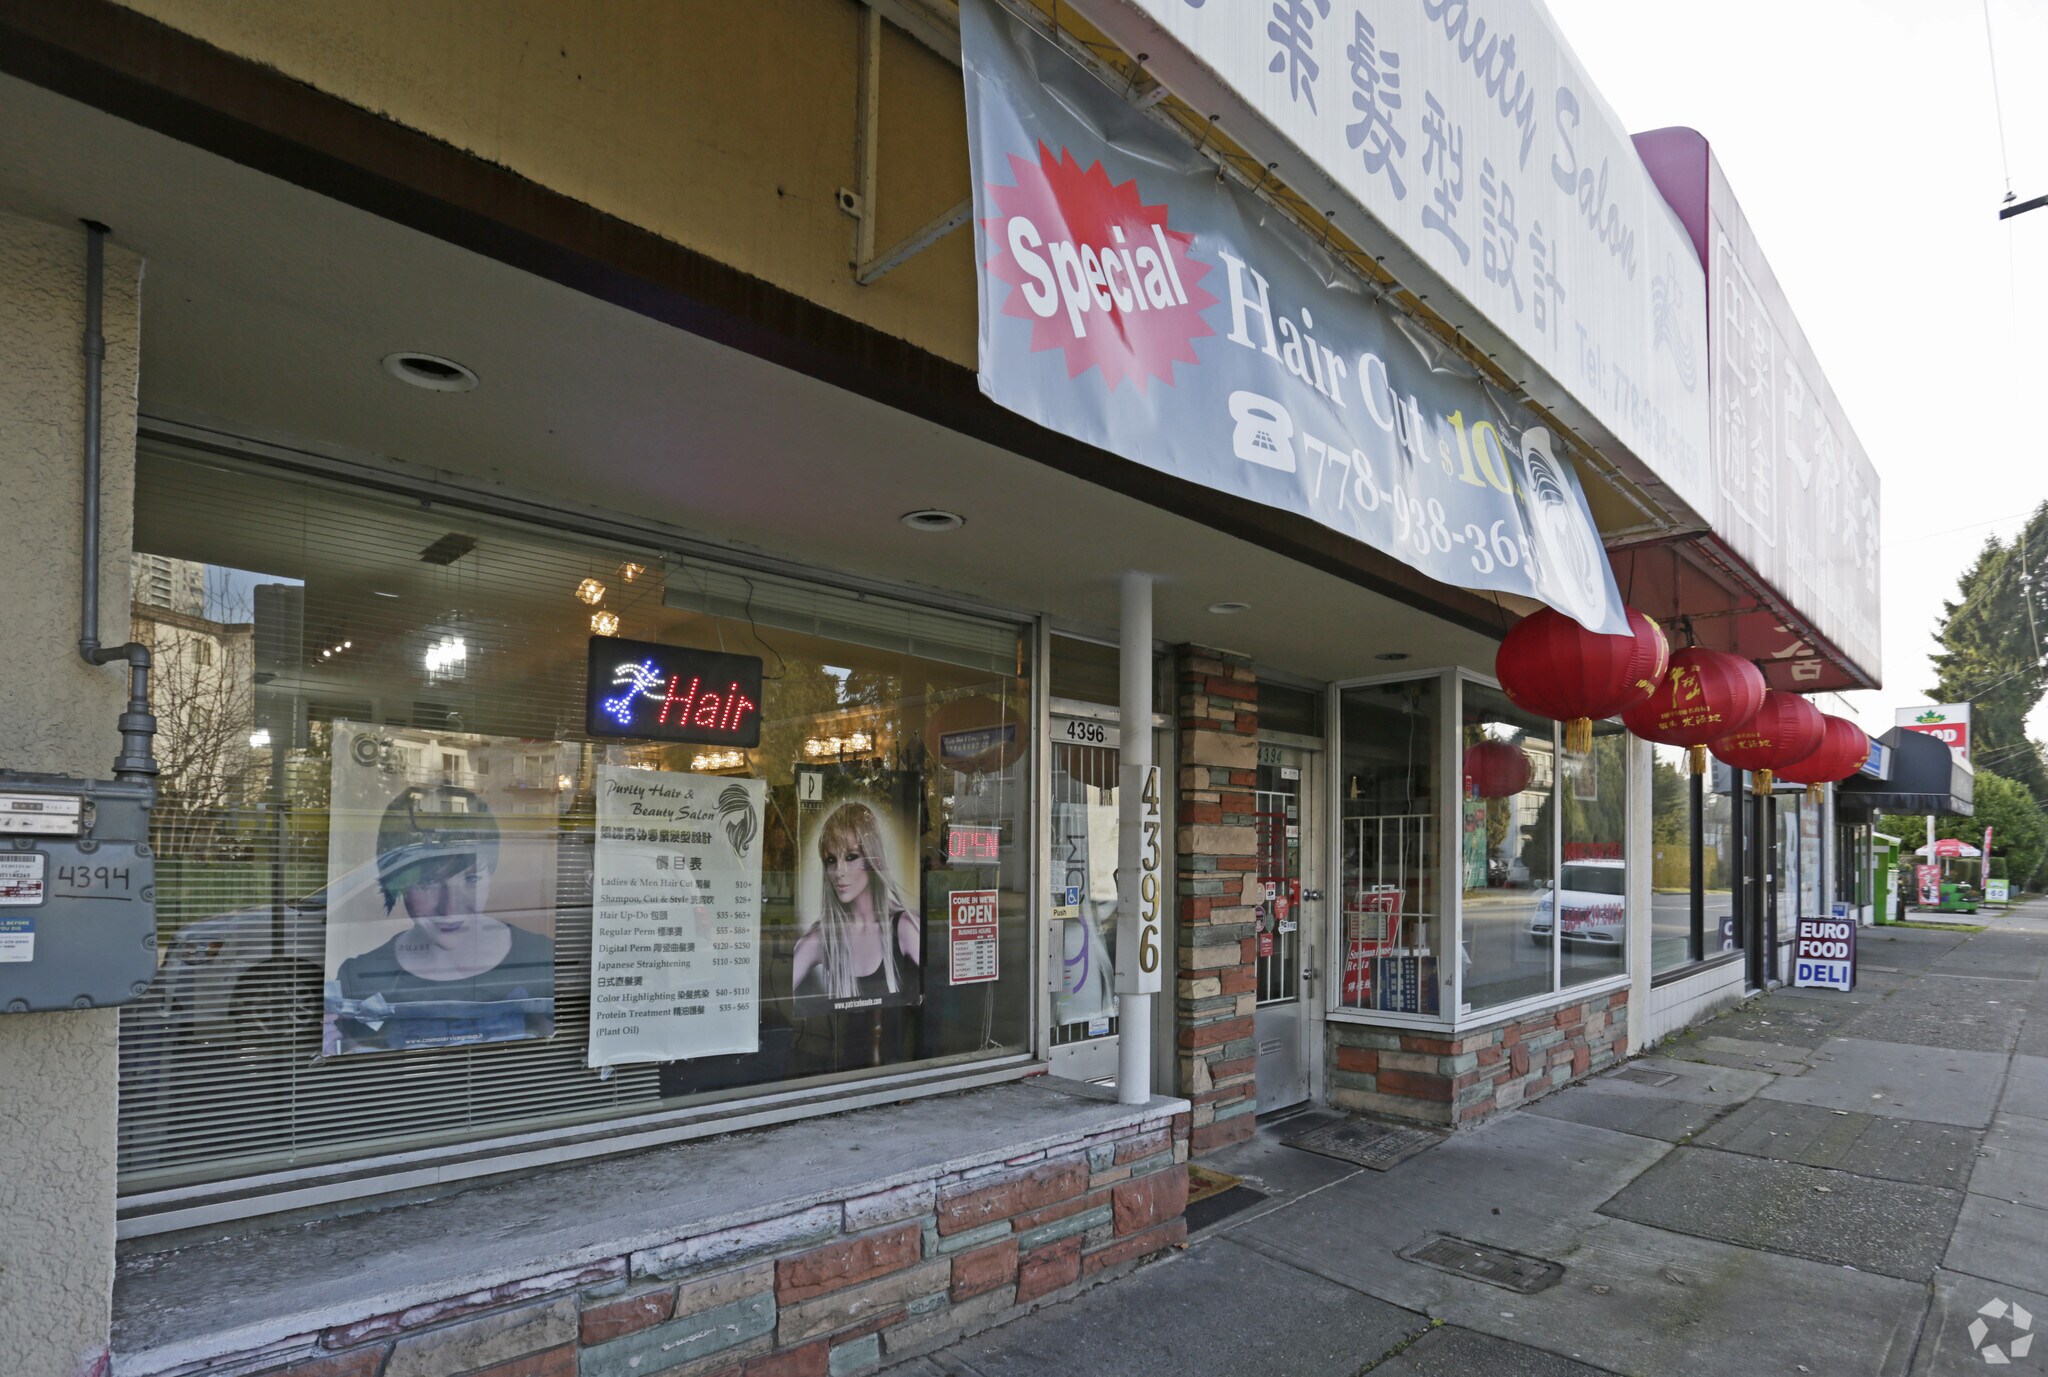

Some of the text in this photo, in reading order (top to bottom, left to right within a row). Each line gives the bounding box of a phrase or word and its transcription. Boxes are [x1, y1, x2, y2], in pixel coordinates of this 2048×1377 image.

[1184, 0, 1565, 353] 業髮型設計
[1551, 86, 1637, 282] Salon
[1006, 215, 1189, 339] Special
[1218, 249, 1347, 411] Hair
[1358, 352, 1431, 464] Cut
[659, 675, 754, 730] Hair
[1066, 721, 1105, 744] 4396
[604, 779, 694, 800] Purity Hair &
[630, 803, 715, 822] Beauty Salon
[948, 831, 999, 858] OPEN
[656, 855, 702, 871] 價目表
[1140, 766, 1161, 975] 4396
[58, 866, 130, 891] 4394
[601, 877, 627, 887] Ladies
[629, 878, 637, 887] &
[640, 878, 657, 887] Men
[660, 879, 678, 888] Hair
[679, 879, 693, 888] Cut
[735, 880, 752, 889] $10+
[600, 894, 642, 905] Shampoo,
[643, 895, 658, 903] Cut
[669, 895, 689, 905] Style
[952, 897, 970, 905] COME
[600, 911, 617, 920] Hair
[620, 911, 649, 921] Up-Do
[716, 911, 729, 919] $35
[734, 911, 751, 919] $65+
[957, 904, 993, 925] OPEN
[1053, 909, 1067, 917] Push
[599, 927, 632, 938] Regular
[634, 927, 656, 936] Perm
[1800, 922, 1850, 939] EURO
[598, 944, 628, 955] Digital
[629, 944, 652, 953] Perm
[712, 942, 729, 950] $120
[1799, 940, 1849, 958] FOOD
[598, 961, 635, 972] Japanese
[636, 959, 691, 971] Straightening
[712, 957, 729, 966] $110
[734, 957, 750, 965] $200
[1798, 963, 1848, 983] DELI
[597, 994, 620, 1003] Color
[622, 992, 676, 1004] Highlighting
[715, 988, 728, 996] $40
[733, 987, 750, 995] $110
[596, 1011, 627, 1020] Protein
[629, 1009, 671, 1018] Treatment
[719, 1003, 732, 1012] $35
[737, 1002, 750, 1011] $65
[596, 1026, 640, 1038] (Plant Oil)
